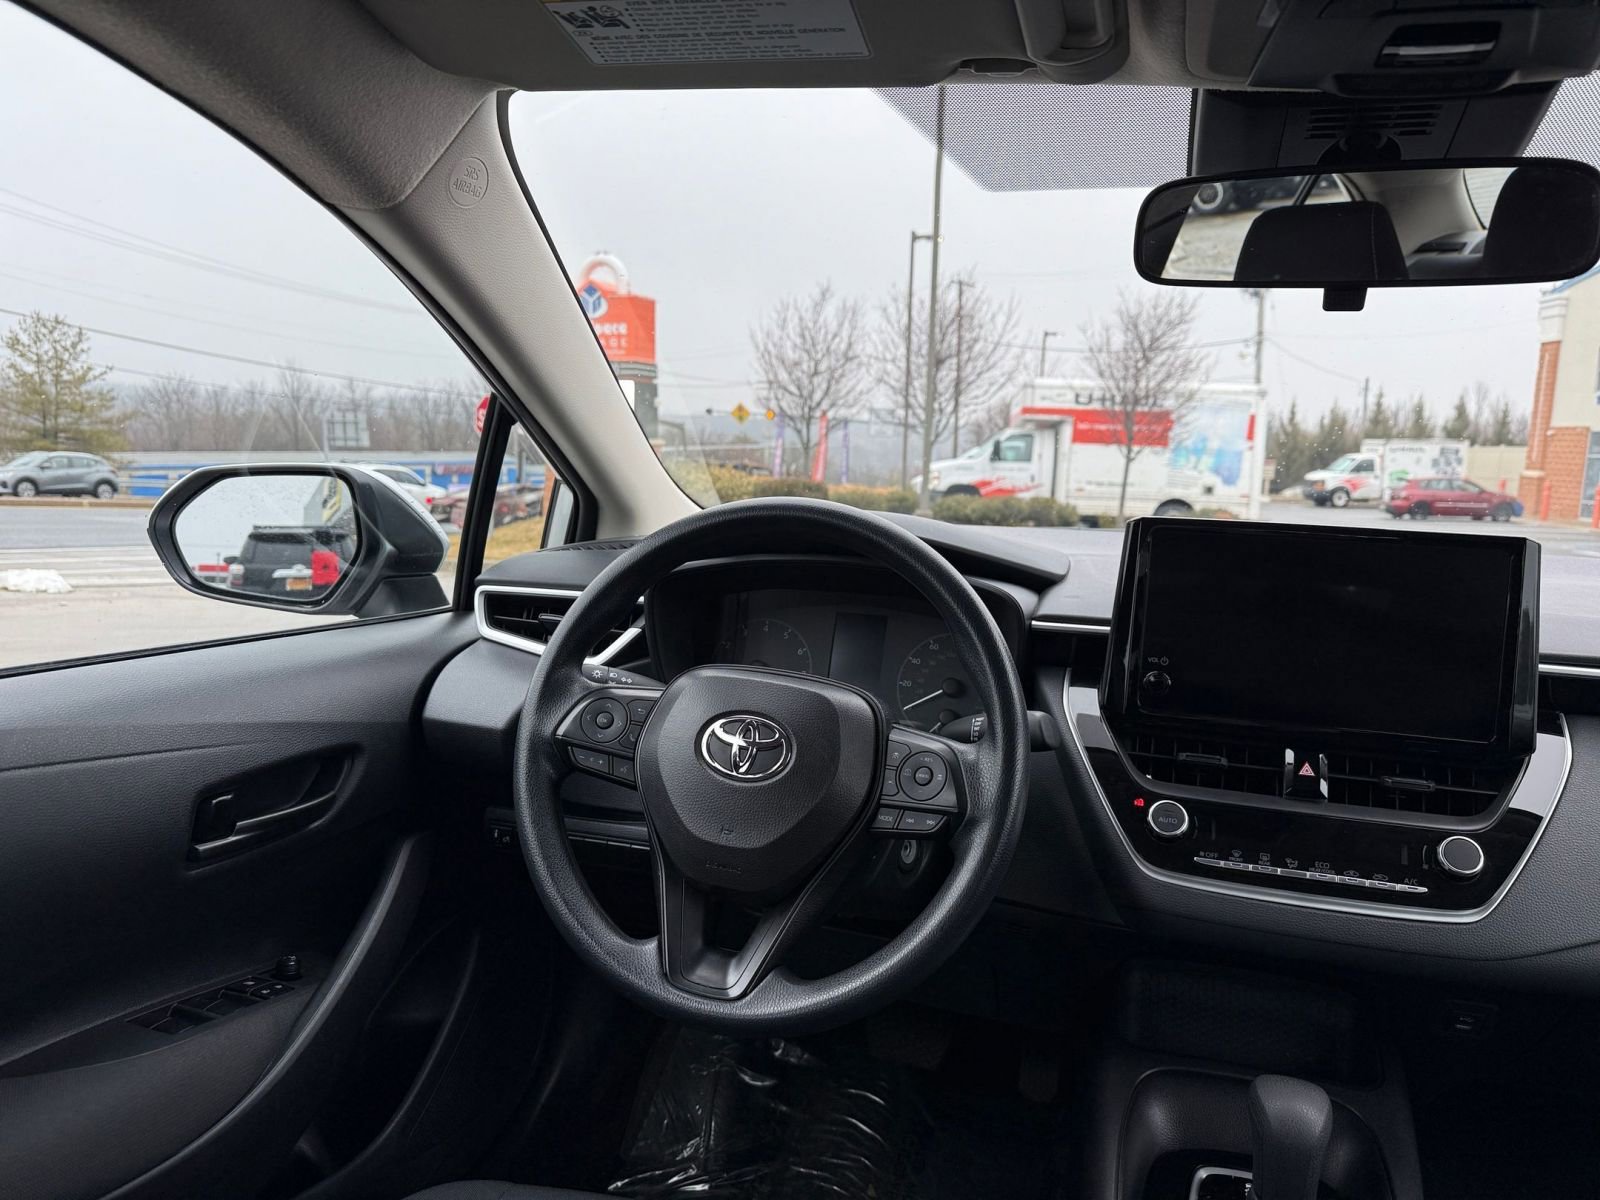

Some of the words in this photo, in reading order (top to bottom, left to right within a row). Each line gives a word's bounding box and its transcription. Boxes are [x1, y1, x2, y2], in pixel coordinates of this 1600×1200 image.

[464, 165, 481, 181] SRS
[451, 177, 483, 198] AIRBAG
[1158, 816, 1178, 824] AUTO
[1205, 851, 1219, 859] OFF
[1314, 861, 1330, 869] ECO
[1403, 877, 1419, 886] A/C
